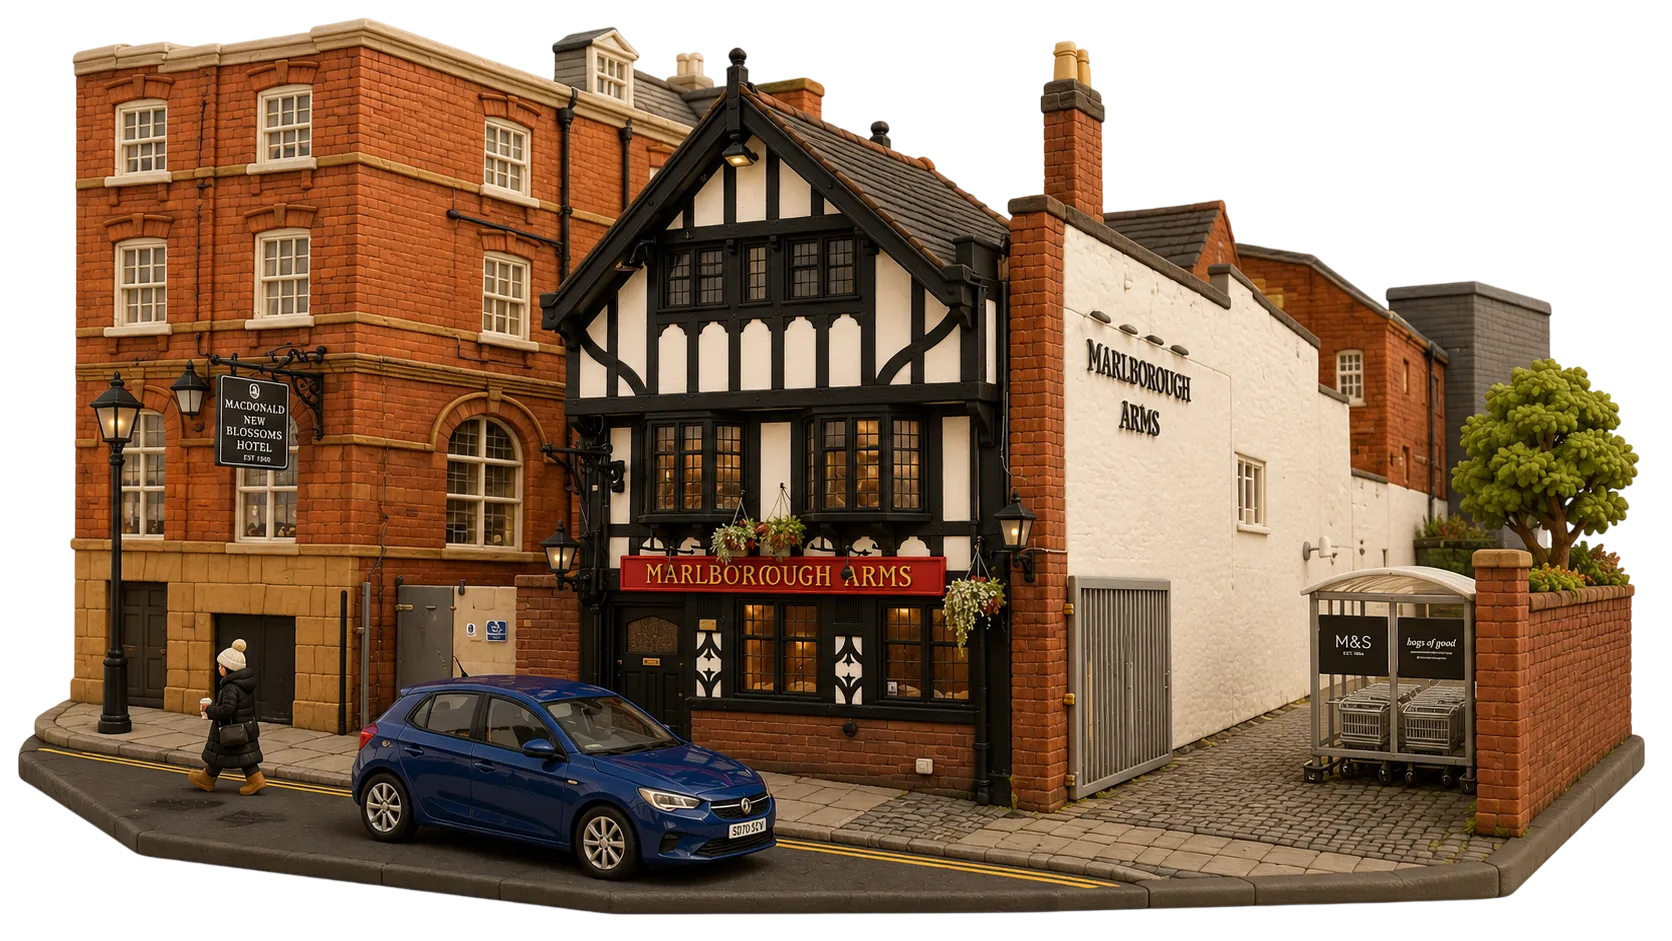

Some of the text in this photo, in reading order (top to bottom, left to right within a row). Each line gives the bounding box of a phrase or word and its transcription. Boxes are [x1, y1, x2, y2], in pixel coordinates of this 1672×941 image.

[1086, 338, 1191, 402] MARLBOROUGH
[225, 398, 285, 414] MACDONALD
[243, 415, 265, 426] NEW
[1119, 400, 1160, 436] ARMS
[226, 426, 282, 440] BLOSSOMS
[236, 440, 272, 452] HOTEL
[844, 565, 912, 587] ARMS
[1335, 634, 1372, 649] M&S
[1426, 638, 1437, 648] of
[1435, 638, 1457, 649] good
